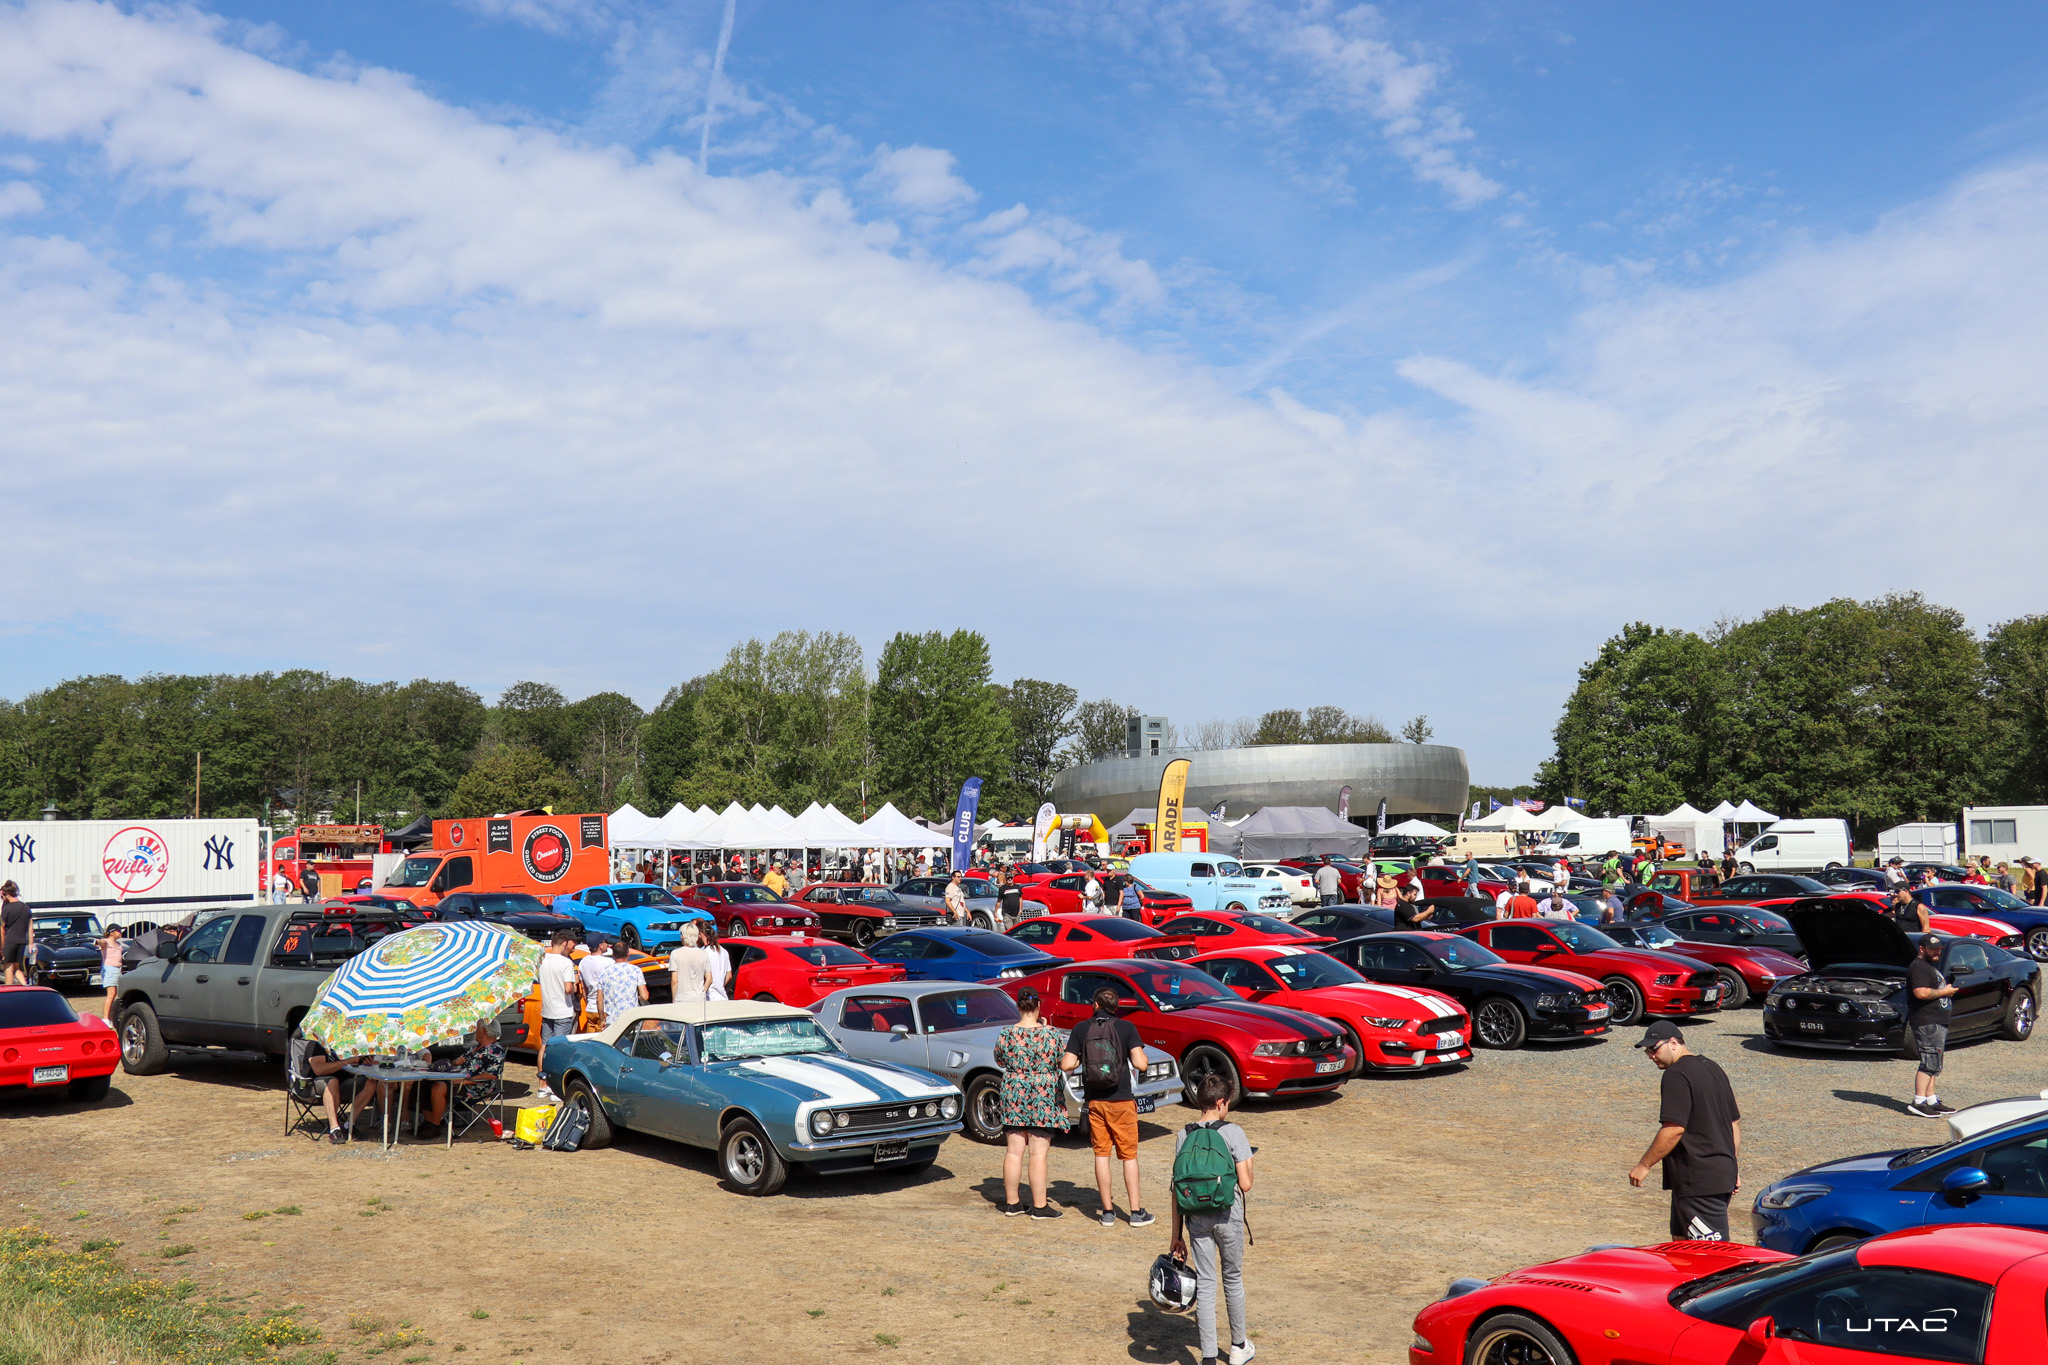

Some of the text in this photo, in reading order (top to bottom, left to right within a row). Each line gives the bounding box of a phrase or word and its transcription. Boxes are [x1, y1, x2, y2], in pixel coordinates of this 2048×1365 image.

[530, 827, 563, 839] STREET FOOD
[958, 810, 971, 843] CLUB
[1163, 797, 1179, 852] ARADE
[8, 833, 36, 863] NY
[203, 834, 235, 870] NY
[104, 857, 168, 877] Willy's
[524, 849, 536, 874] GRILLED
[535, 872, 555, 880] CHEESE
[555, 861, 568, 877] SINCE
